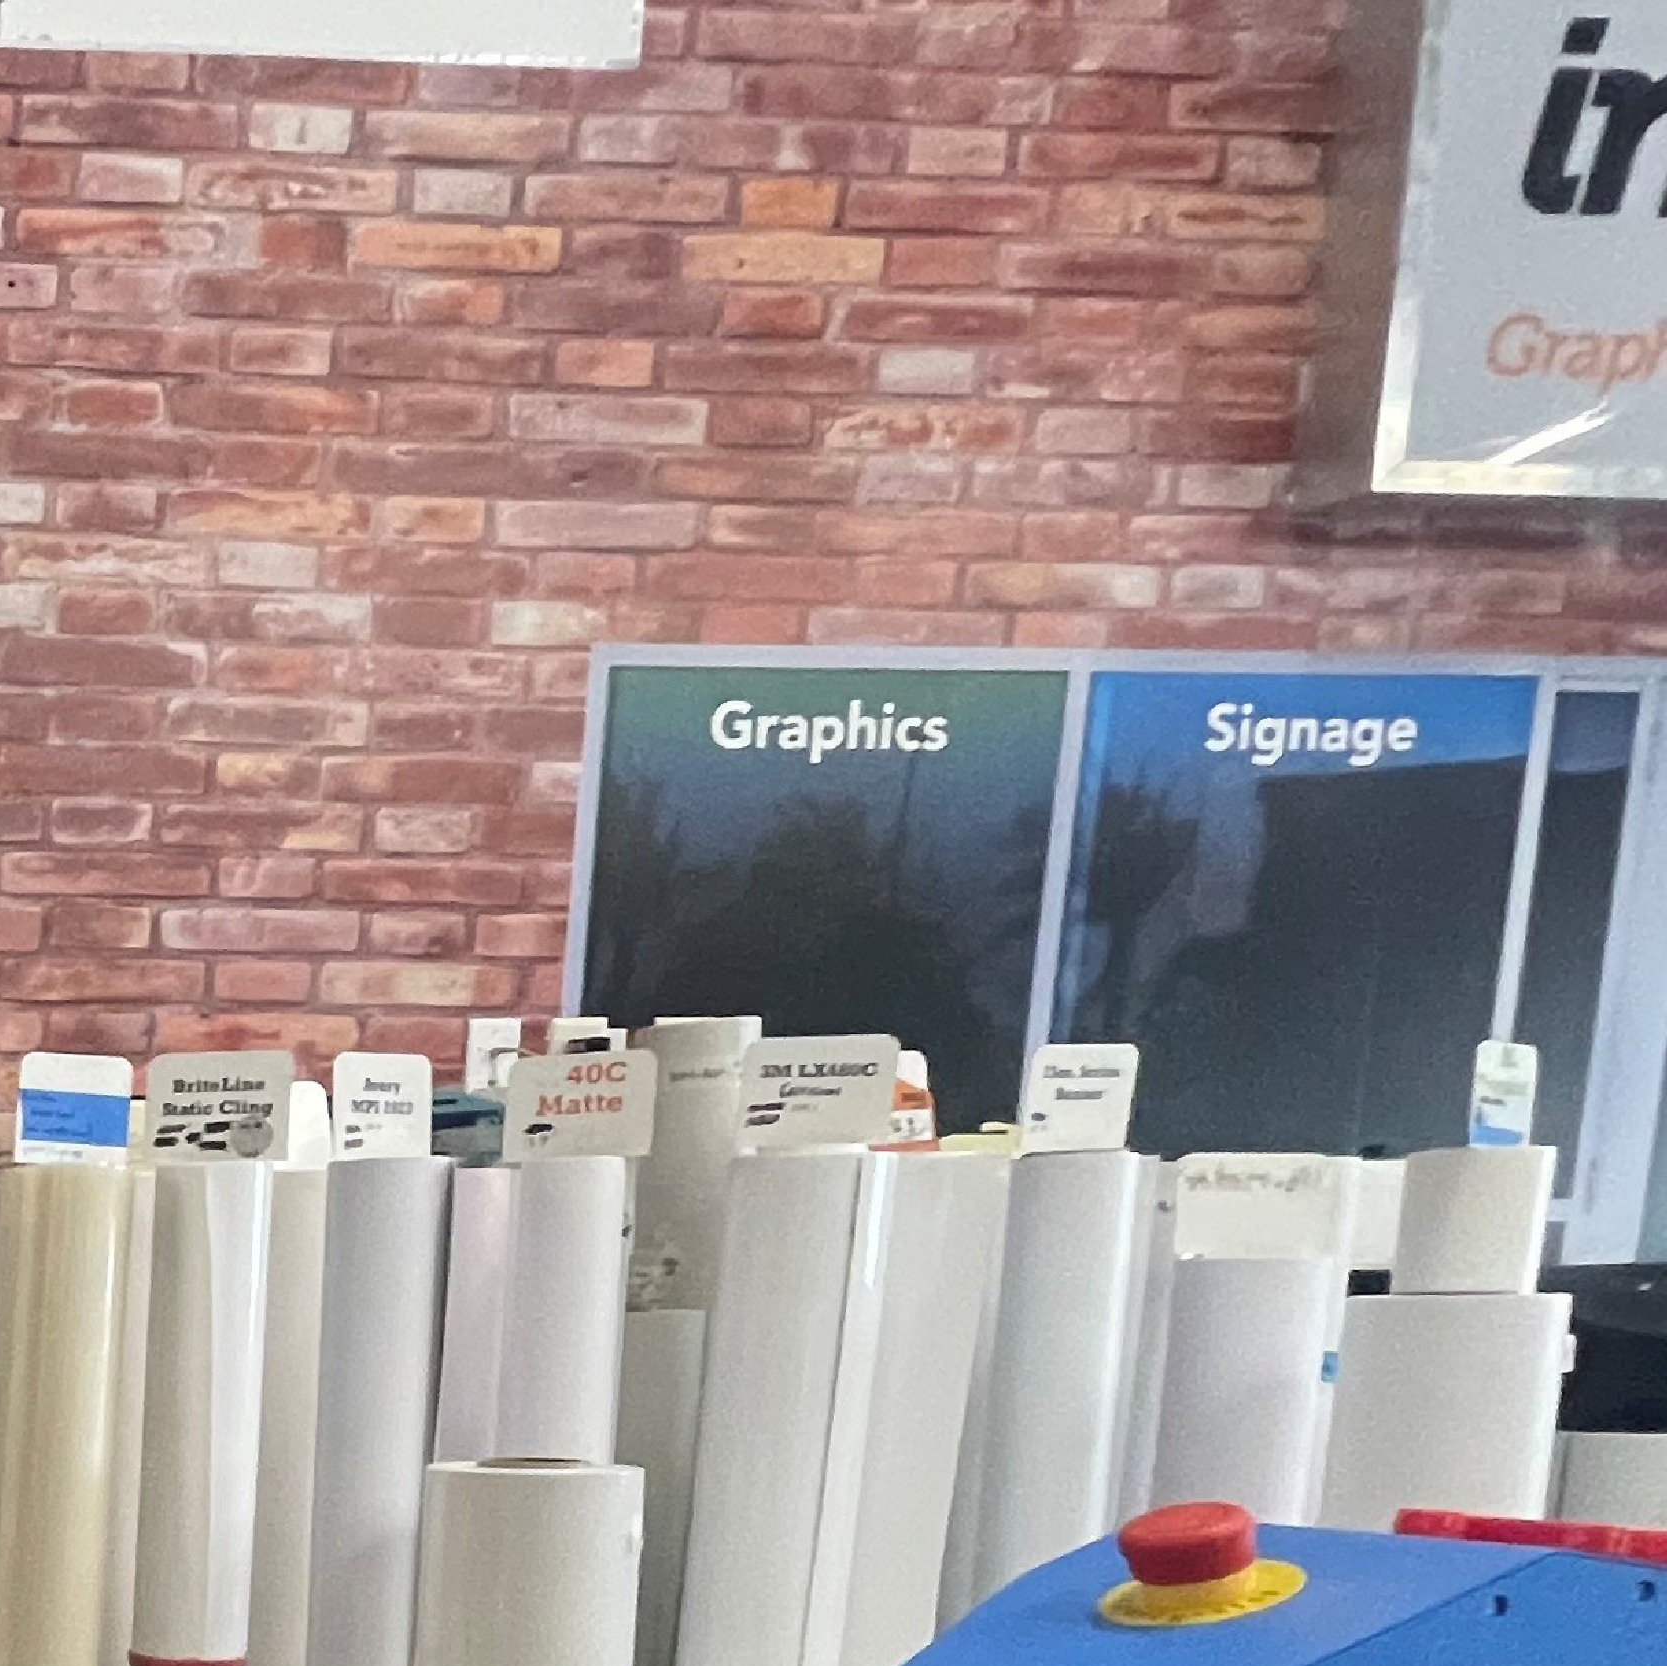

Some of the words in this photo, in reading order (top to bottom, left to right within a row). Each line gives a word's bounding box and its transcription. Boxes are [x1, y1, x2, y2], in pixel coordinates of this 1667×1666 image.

[711, 700, 947, 763] Graphics
[1205, 703, 1417, 766] Signage
[566, 1061, 627, 1084] 40C
[535, 1093, 623, 1117] Matte
